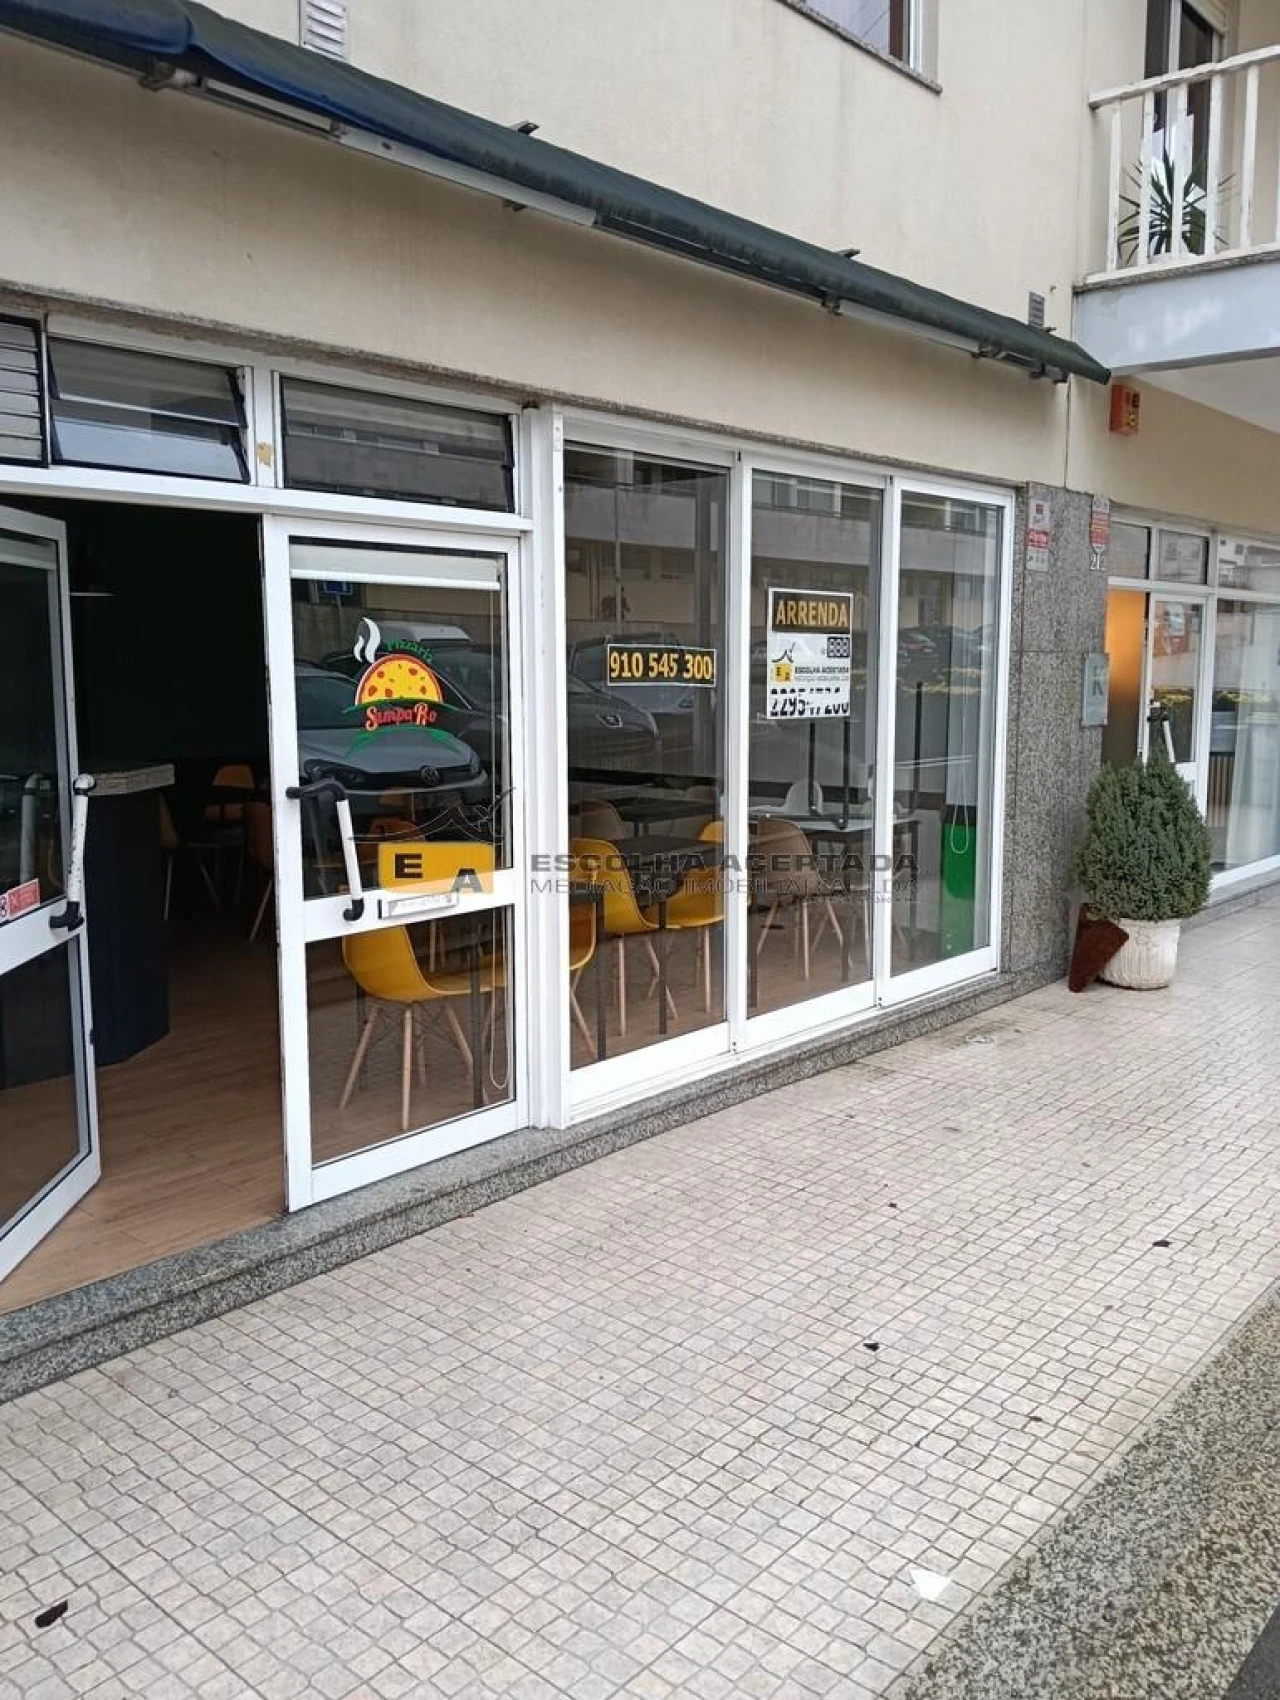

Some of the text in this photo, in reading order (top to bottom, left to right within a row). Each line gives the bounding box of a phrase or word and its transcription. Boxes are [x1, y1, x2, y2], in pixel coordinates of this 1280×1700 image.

[776, 601, 848, 627] ARRENDA
[610, 651, 713, 680] 910 545 300
